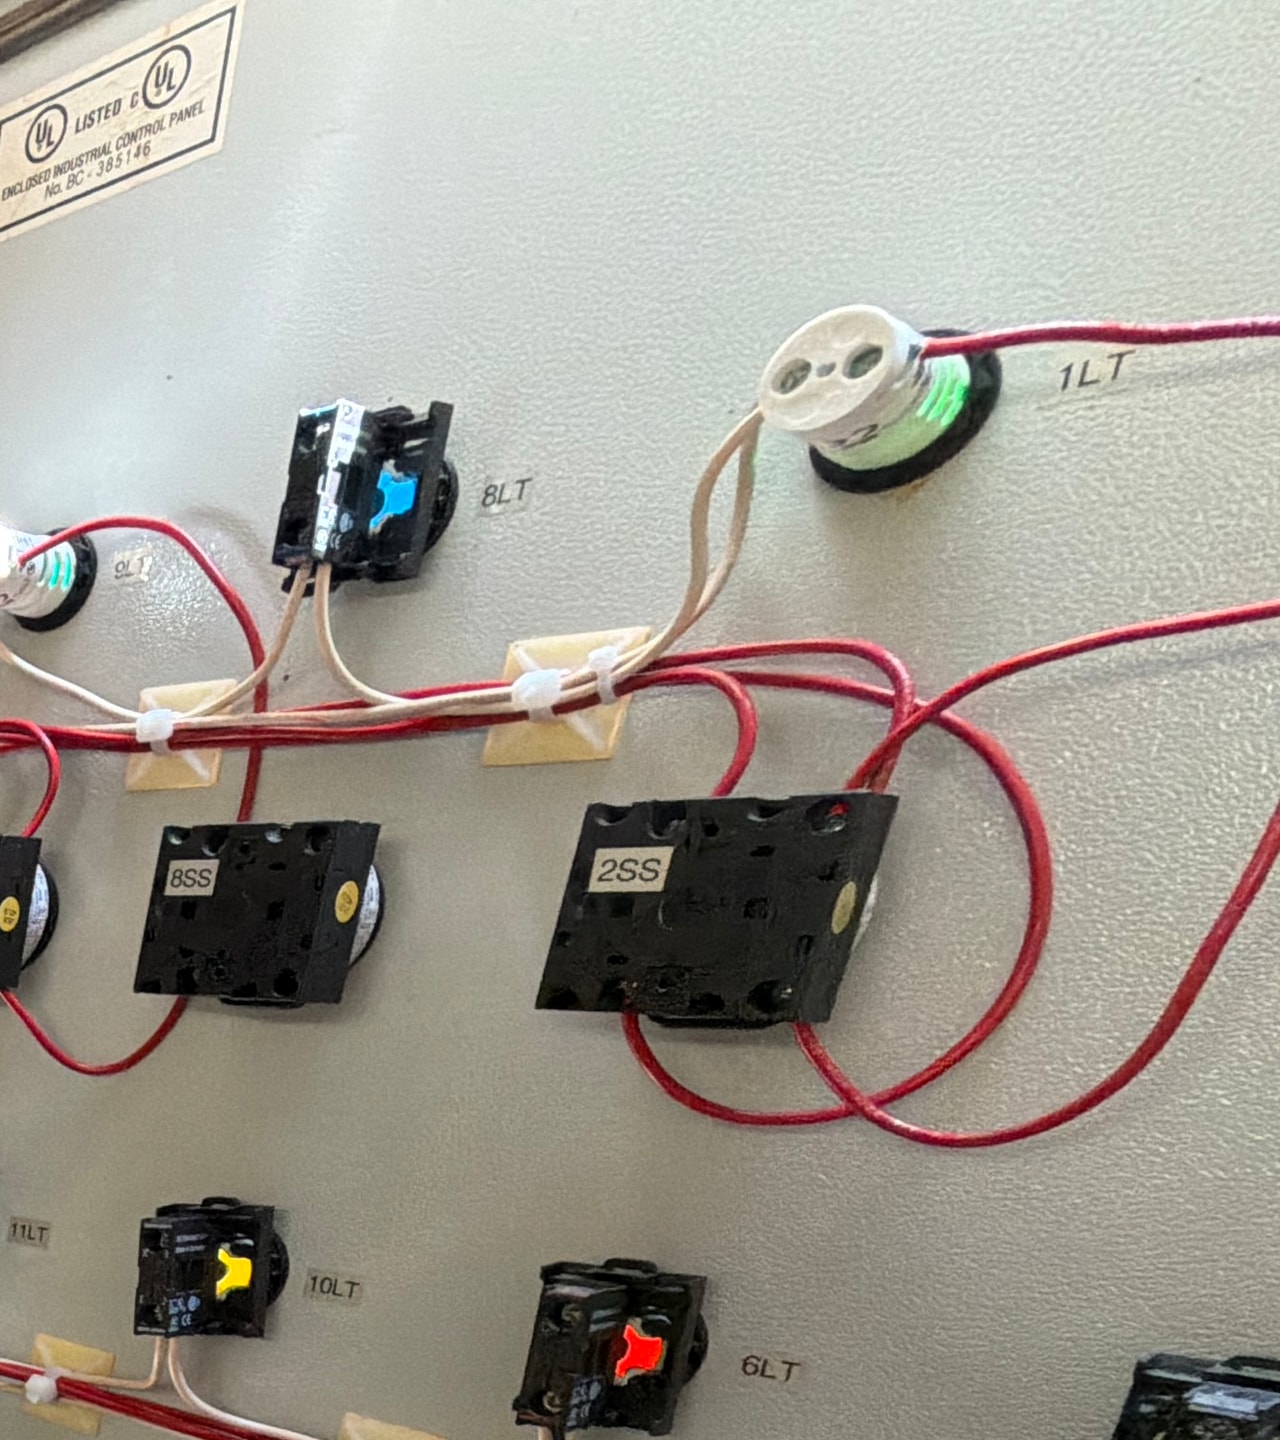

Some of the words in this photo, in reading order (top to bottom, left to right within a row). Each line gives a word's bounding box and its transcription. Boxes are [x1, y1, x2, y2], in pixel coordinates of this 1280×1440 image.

[74, 97, 123, 134] LISTED
[1, 168, 52, 201] ENCLOSED
[52, 142, 113, 180] INDUSTRIAL
[115, 116, 167, 152] CONTROL
[168, 98, 206, 129] PANEL
[43, 182, 63, 201] No.
[65, 169, 86, 192] BC
[95, 140, 153, 178] 385146
[1059, 348, 1138, 392] 1LT
[480, 476, 534, 508] 8LT
[169, 866, 213, 889] 8SS
[599, 857, 663, 883] 2SS
[11, 1221, 49, 1243] 11LT
[309, 1275, 361, 1300] 10LT
[740, 1354, 801, 1382] 6LT
